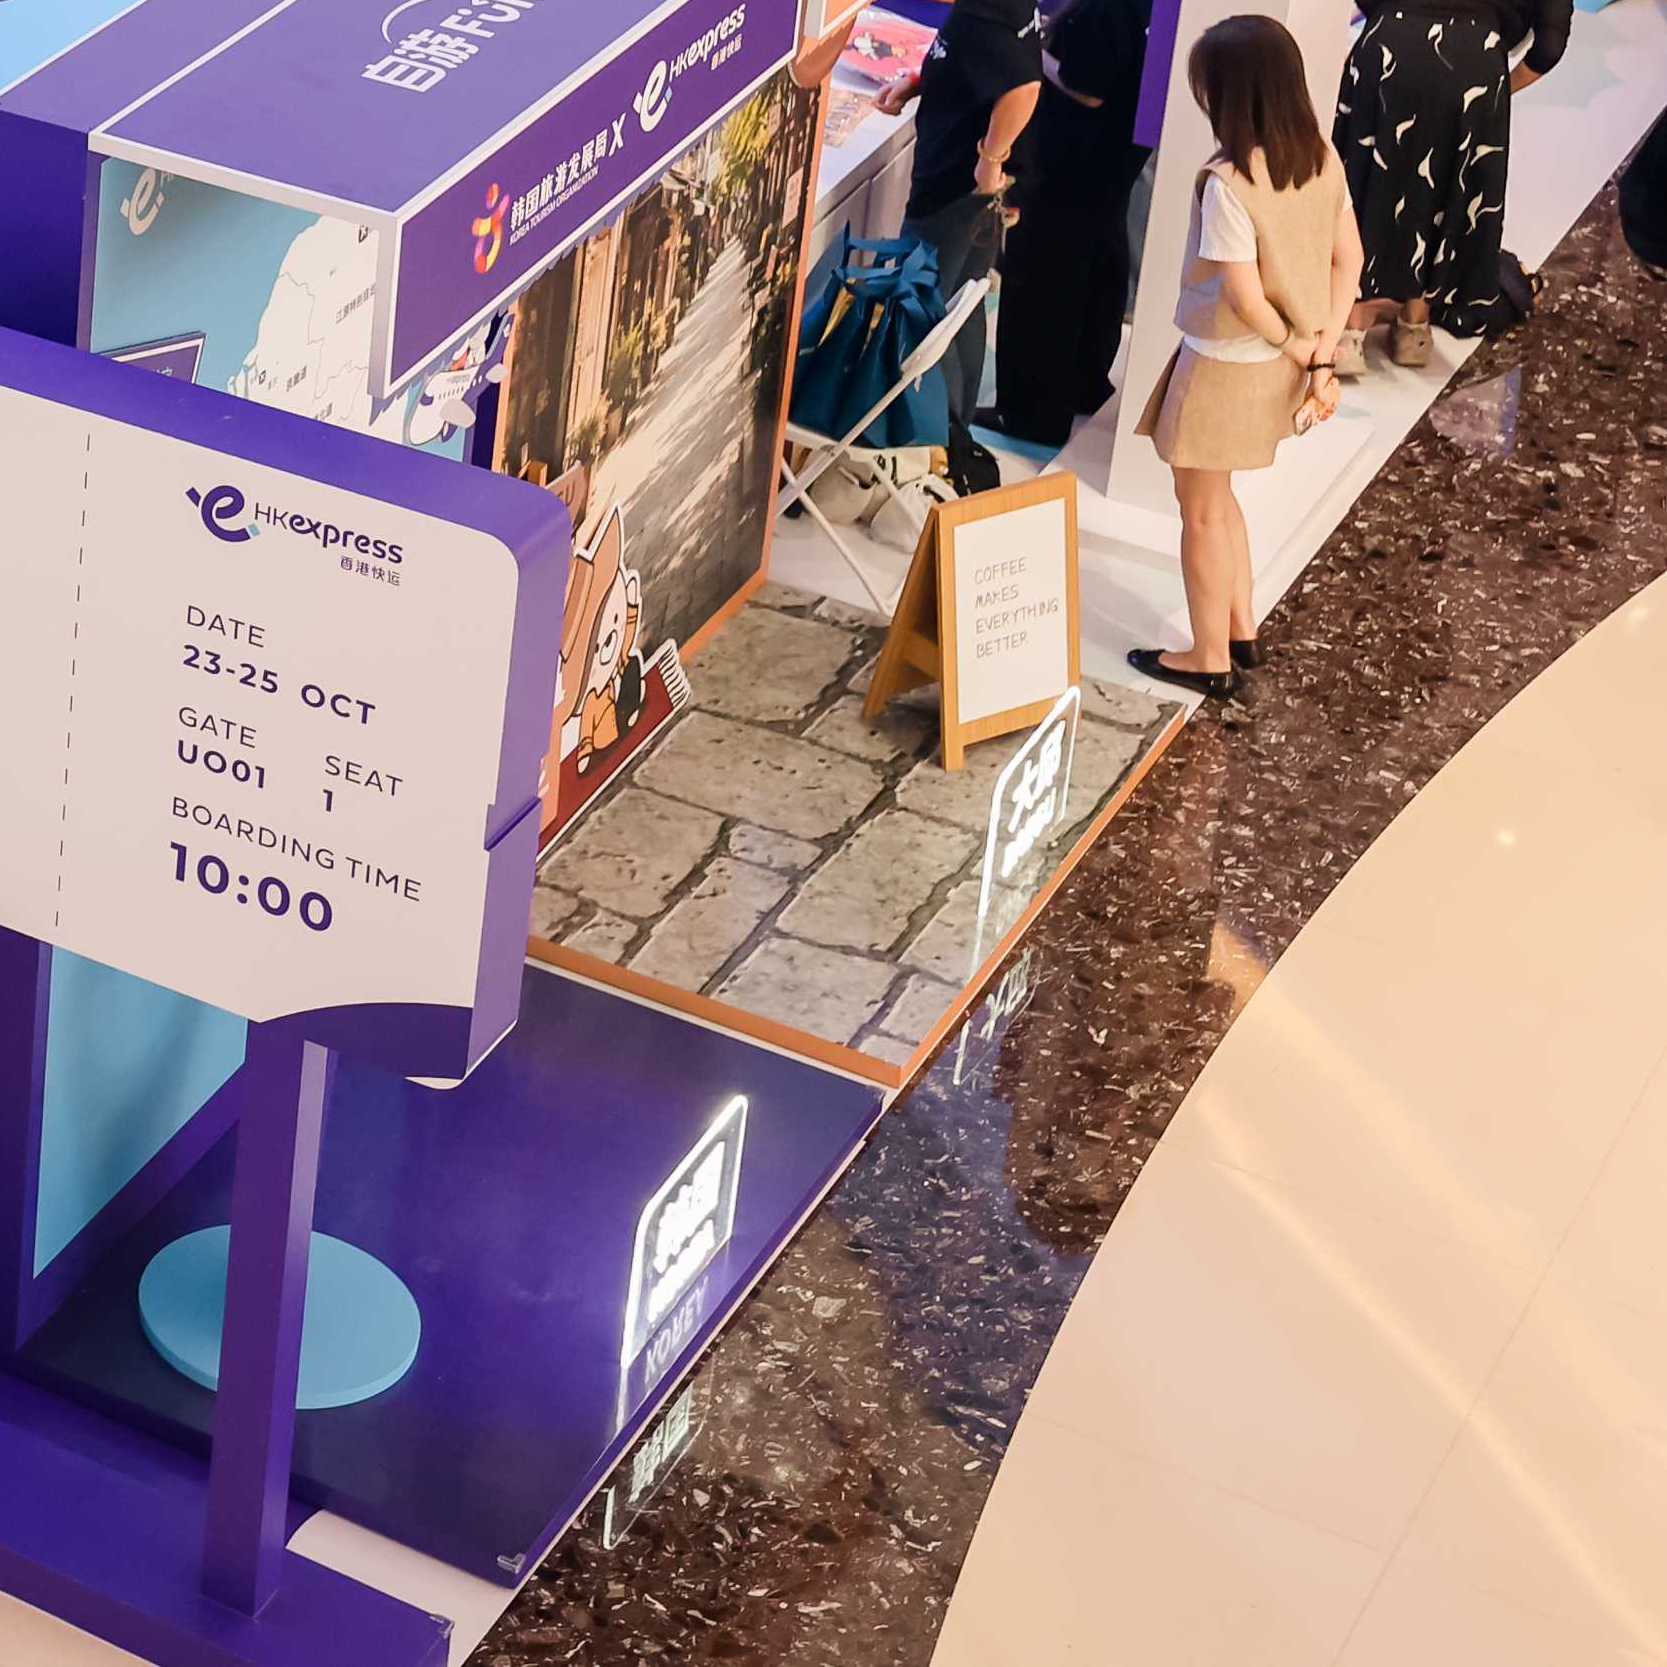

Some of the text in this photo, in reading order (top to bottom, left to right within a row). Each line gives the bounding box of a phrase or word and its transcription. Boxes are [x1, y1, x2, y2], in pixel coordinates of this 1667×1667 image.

[510, 129, 608, 232] 韩国旅游发展局
[669, 3, 746, 83] HKexpress
[253, 500, 404, 565] HKexpress
[339, 554, 402, 588] 香港快运
[974, 556, 1027, 585] COFFEE
[974, 584, 1019, 610] MAKES
[975, 597, 1060, 636] EVERYTHING
[186, 604, 266, 648] DATE
[976, 629, 1029, 659] BETTER
[182, 643, 376, 725] 23-25 OCT
[178, 705, 257, 749] GATE
[323, 753, 404, 797] SEAT
[321, 788, 334, 813] 1
[171, 796, 422, 903] BOARDING TIME
[169, 840, 334, 933] 10:00
